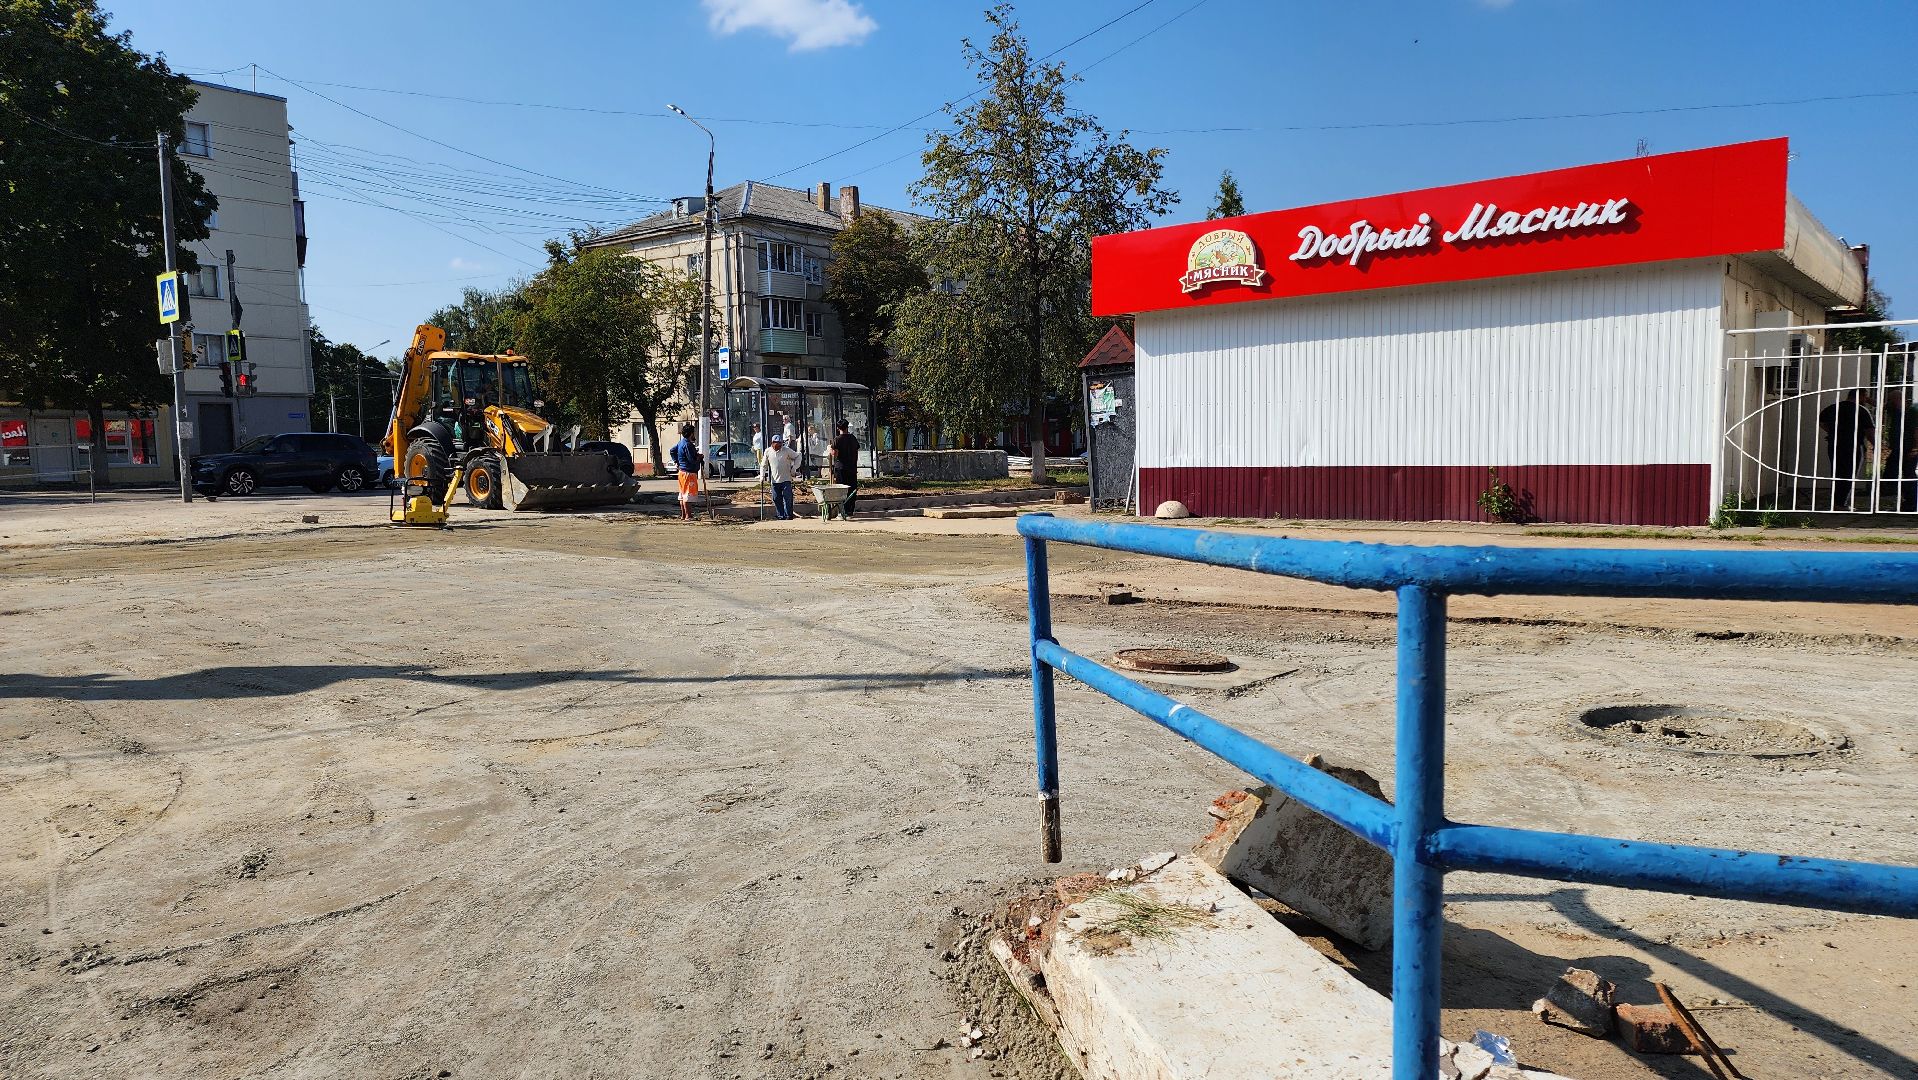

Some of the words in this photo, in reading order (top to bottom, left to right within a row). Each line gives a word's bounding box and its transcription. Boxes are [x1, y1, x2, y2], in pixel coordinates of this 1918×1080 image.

[1198, 231, 1244, 249] ДОБРЫЙ
[1289, 213, 1431, 265] Добрый
[1443, 198, 1628, 242] Мясник
[1193, 265, 1249, 282] МЯСНИК
